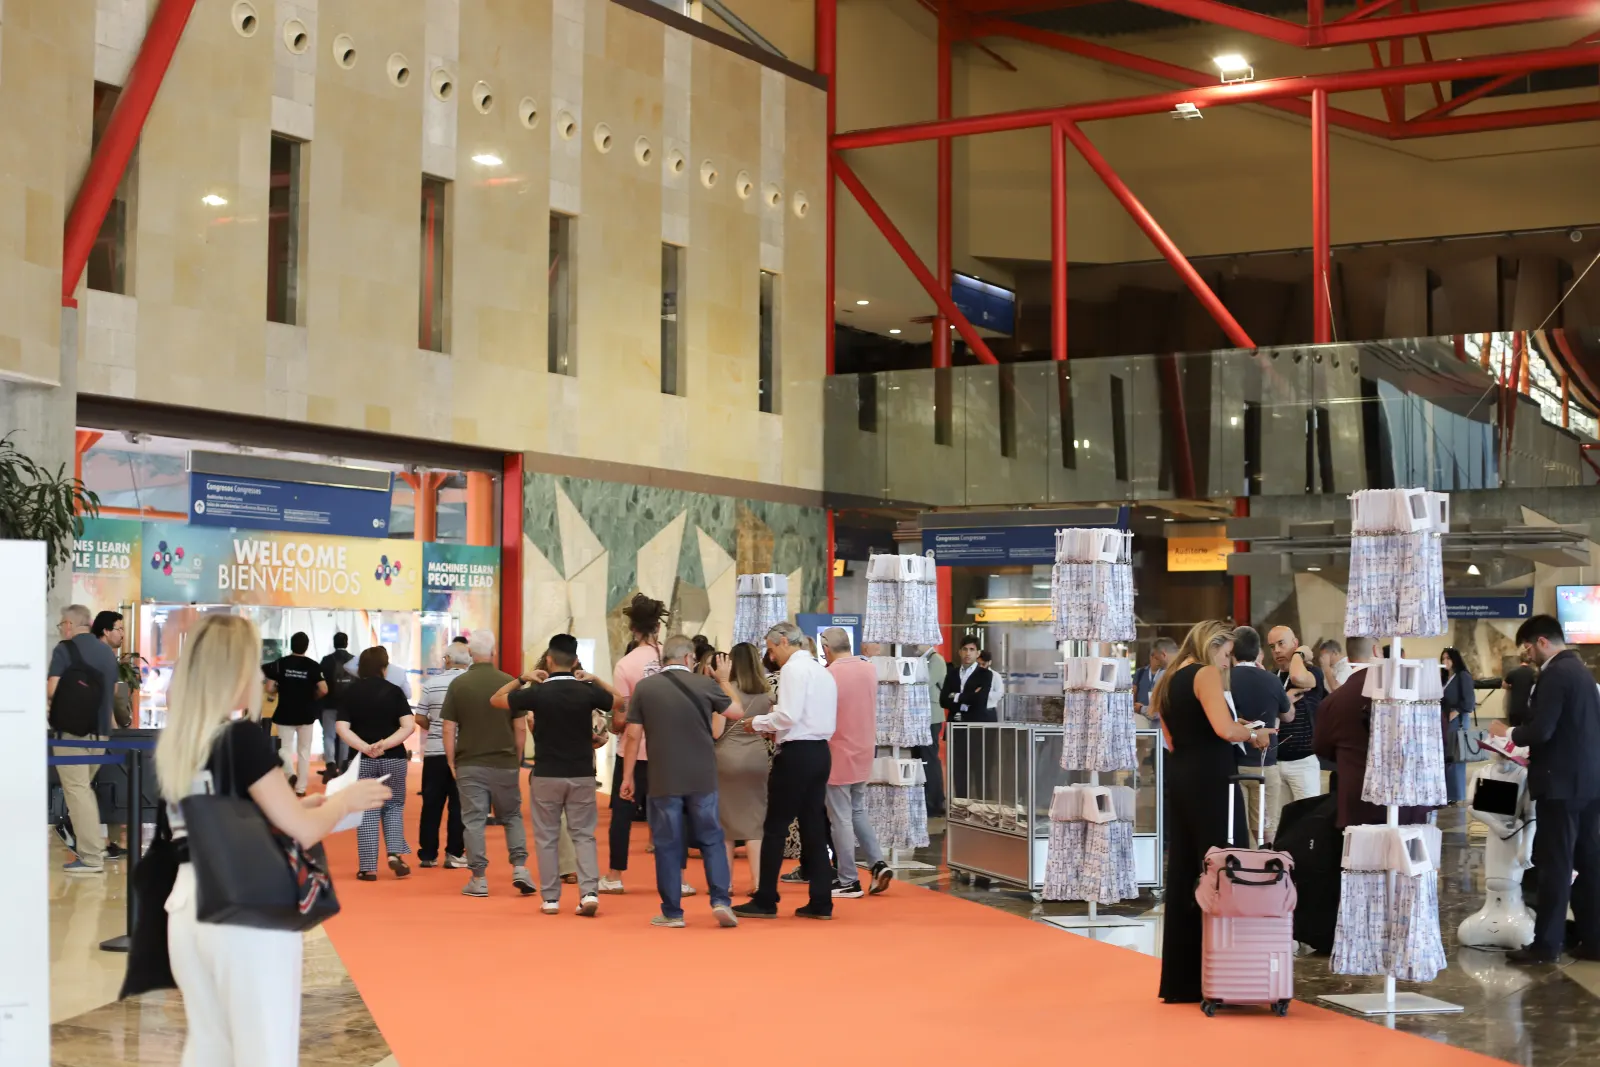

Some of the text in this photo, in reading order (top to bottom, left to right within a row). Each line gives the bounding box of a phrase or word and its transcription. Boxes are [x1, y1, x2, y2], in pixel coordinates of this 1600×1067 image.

[206, 482, 261, 495] Congresos Congresses
[73, 540, 130, 554] NES LEARN
[233, 538, 347, 569] WELCOME
[95, 557, 130, 569] LEAD
[428, 562, 493, 574] MACHINES LEARN
[218, 563, 361, 595] BIENVENIDOS
[428, 573, 466, 587] PEOPLE
[468, 574, 493, 588] LEAD
[1518, 603, 1528, 616] D
